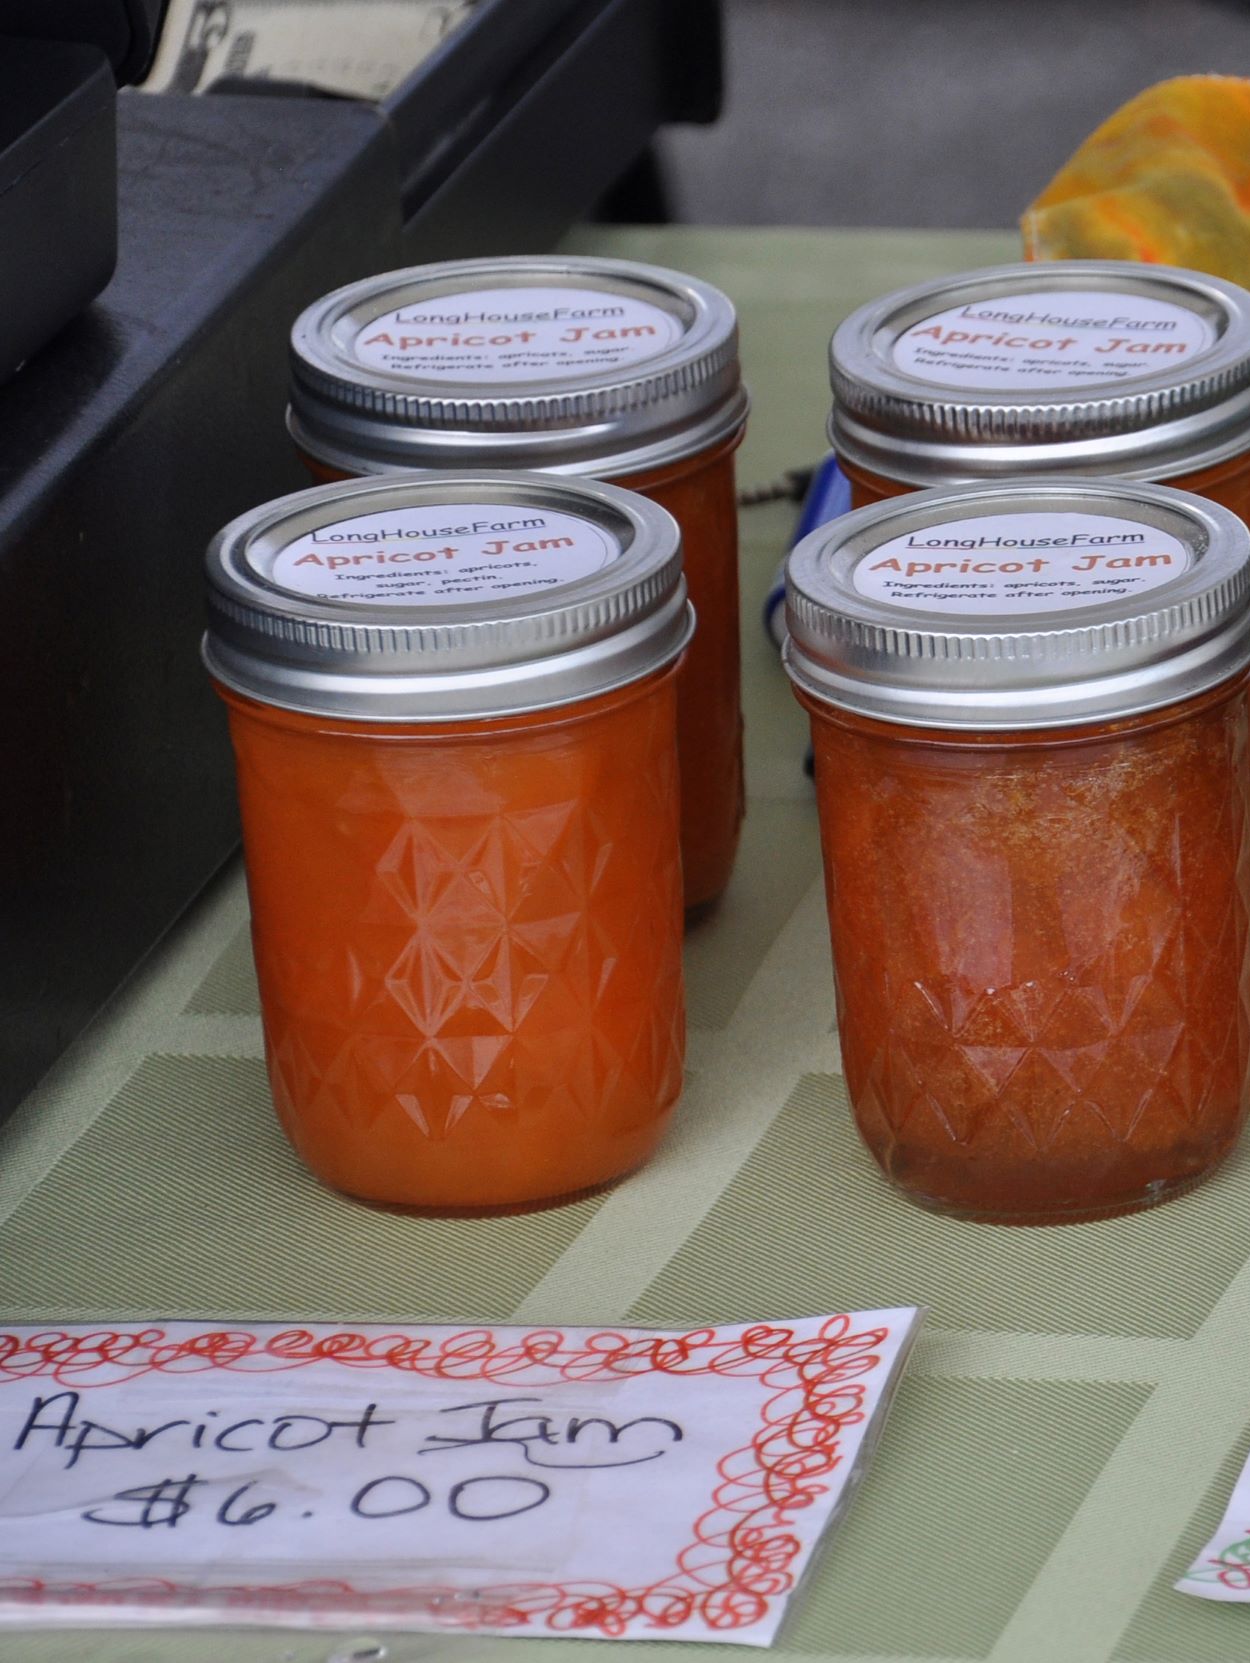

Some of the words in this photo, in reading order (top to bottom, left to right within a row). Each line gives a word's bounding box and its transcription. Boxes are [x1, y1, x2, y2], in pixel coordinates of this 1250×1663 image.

[396, 306, 625, 324] LongHouseFarm
[960, 305, 1177, 331] LongHouseFarm
[364, 330, 535, 350] Apricot
[560, 325, 655, 342] Jam
[912, 325, 1078, 350] Apricot
[1094, 338, 1187, 353] Jam
[311, 517, 547, 544] LongHouseFarm
[905, 531, 1145, 550] LongHouseFarm
[293, 546, 459, 569] Apricot
[481, 536, 575, 556] Jam
[869, 558, 1050, 577] Apricot
[1071, 552, 1172, 572] Jam
[335, 569, 448, 580] Ingredients:
[883, 579, 994, 590] Ingredients:
[434, 586, 483, 594] after
[891, 590, 997, 600] Refrigerate
[15, 1391, 397, 1469] Apricot
[417, 1397, 683, 1470] Jam
[82, 1474, 550, 1530] $6.00
